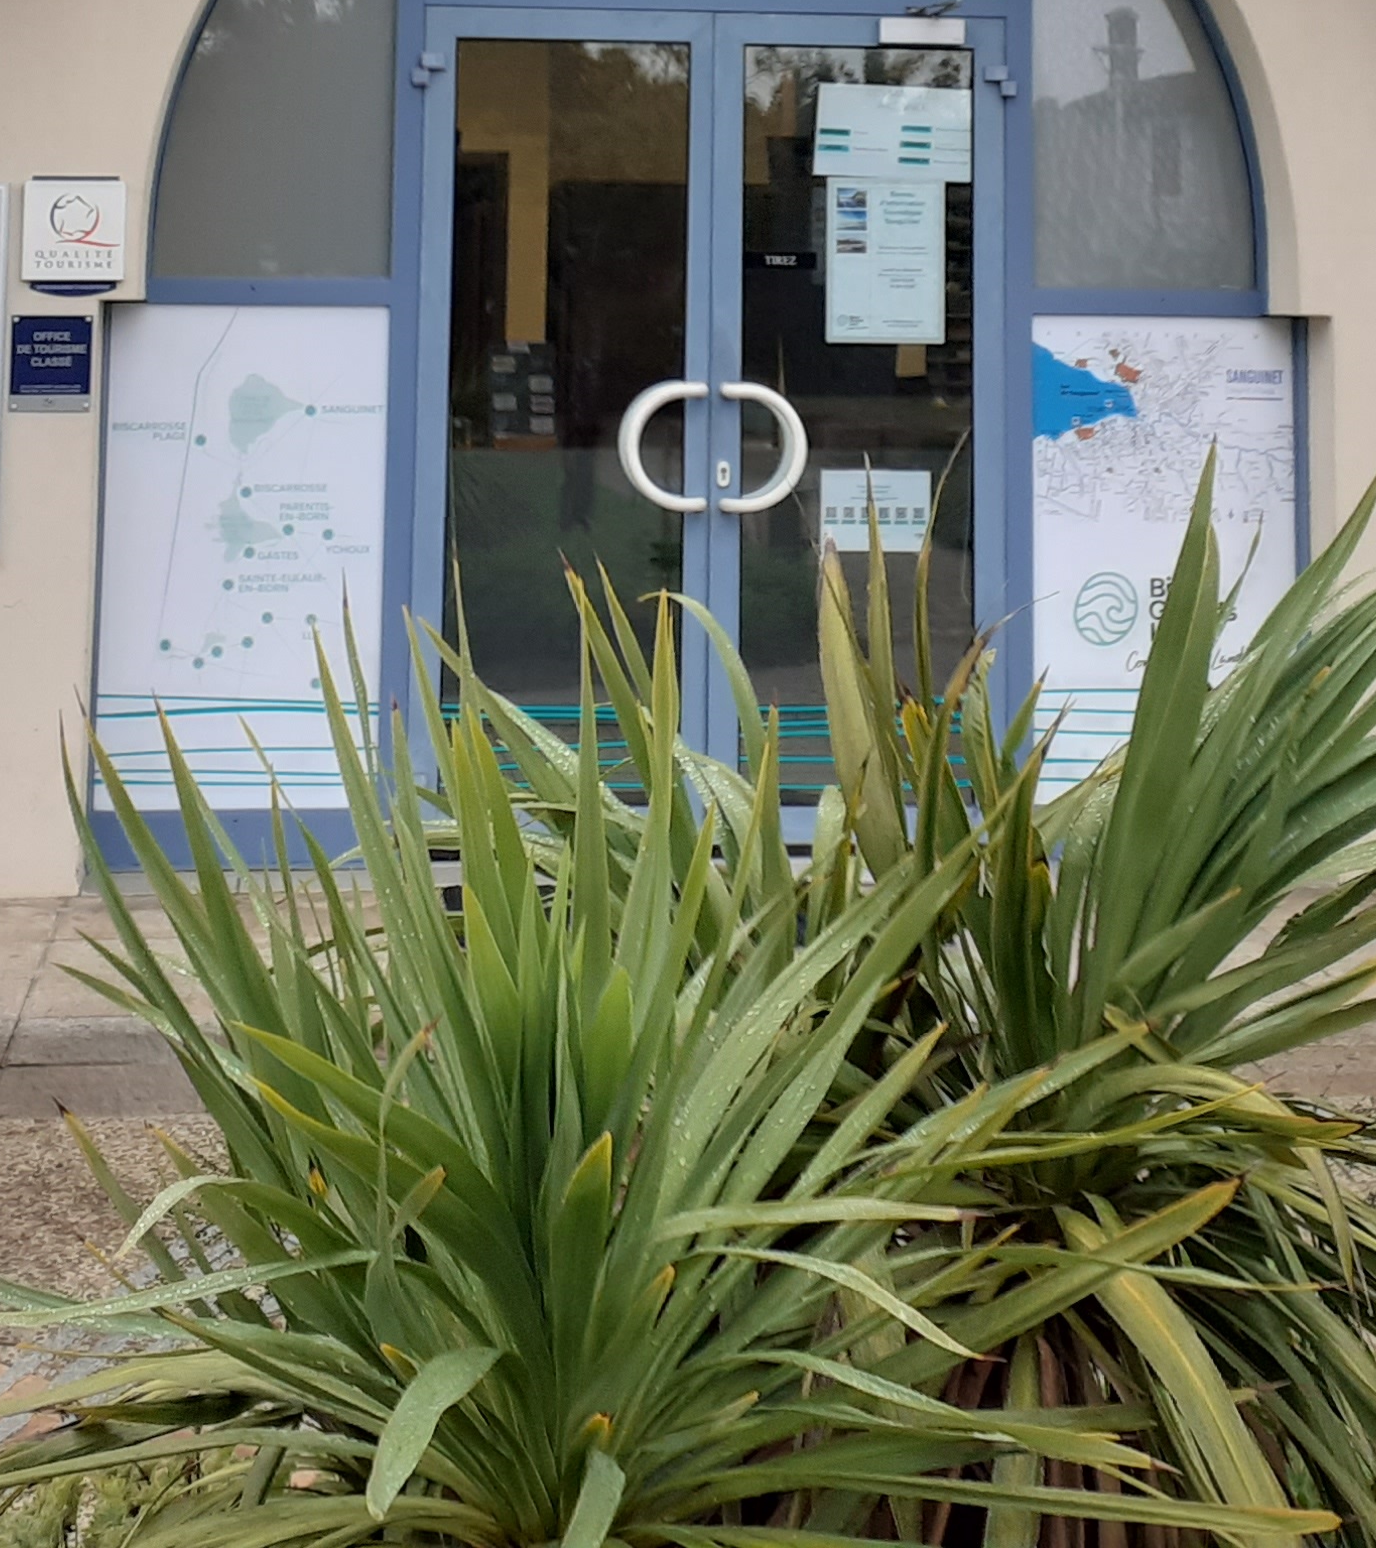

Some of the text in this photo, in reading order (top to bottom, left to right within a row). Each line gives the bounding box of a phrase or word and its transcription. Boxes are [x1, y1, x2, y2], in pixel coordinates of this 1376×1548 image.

[34, 249, 113, 260] QUALITÉ
[34, 260, 113, 269] TOURISME
[33, 331, 71, 342] OFFICE
[16, 344, 87, 354] DE TOURISME
